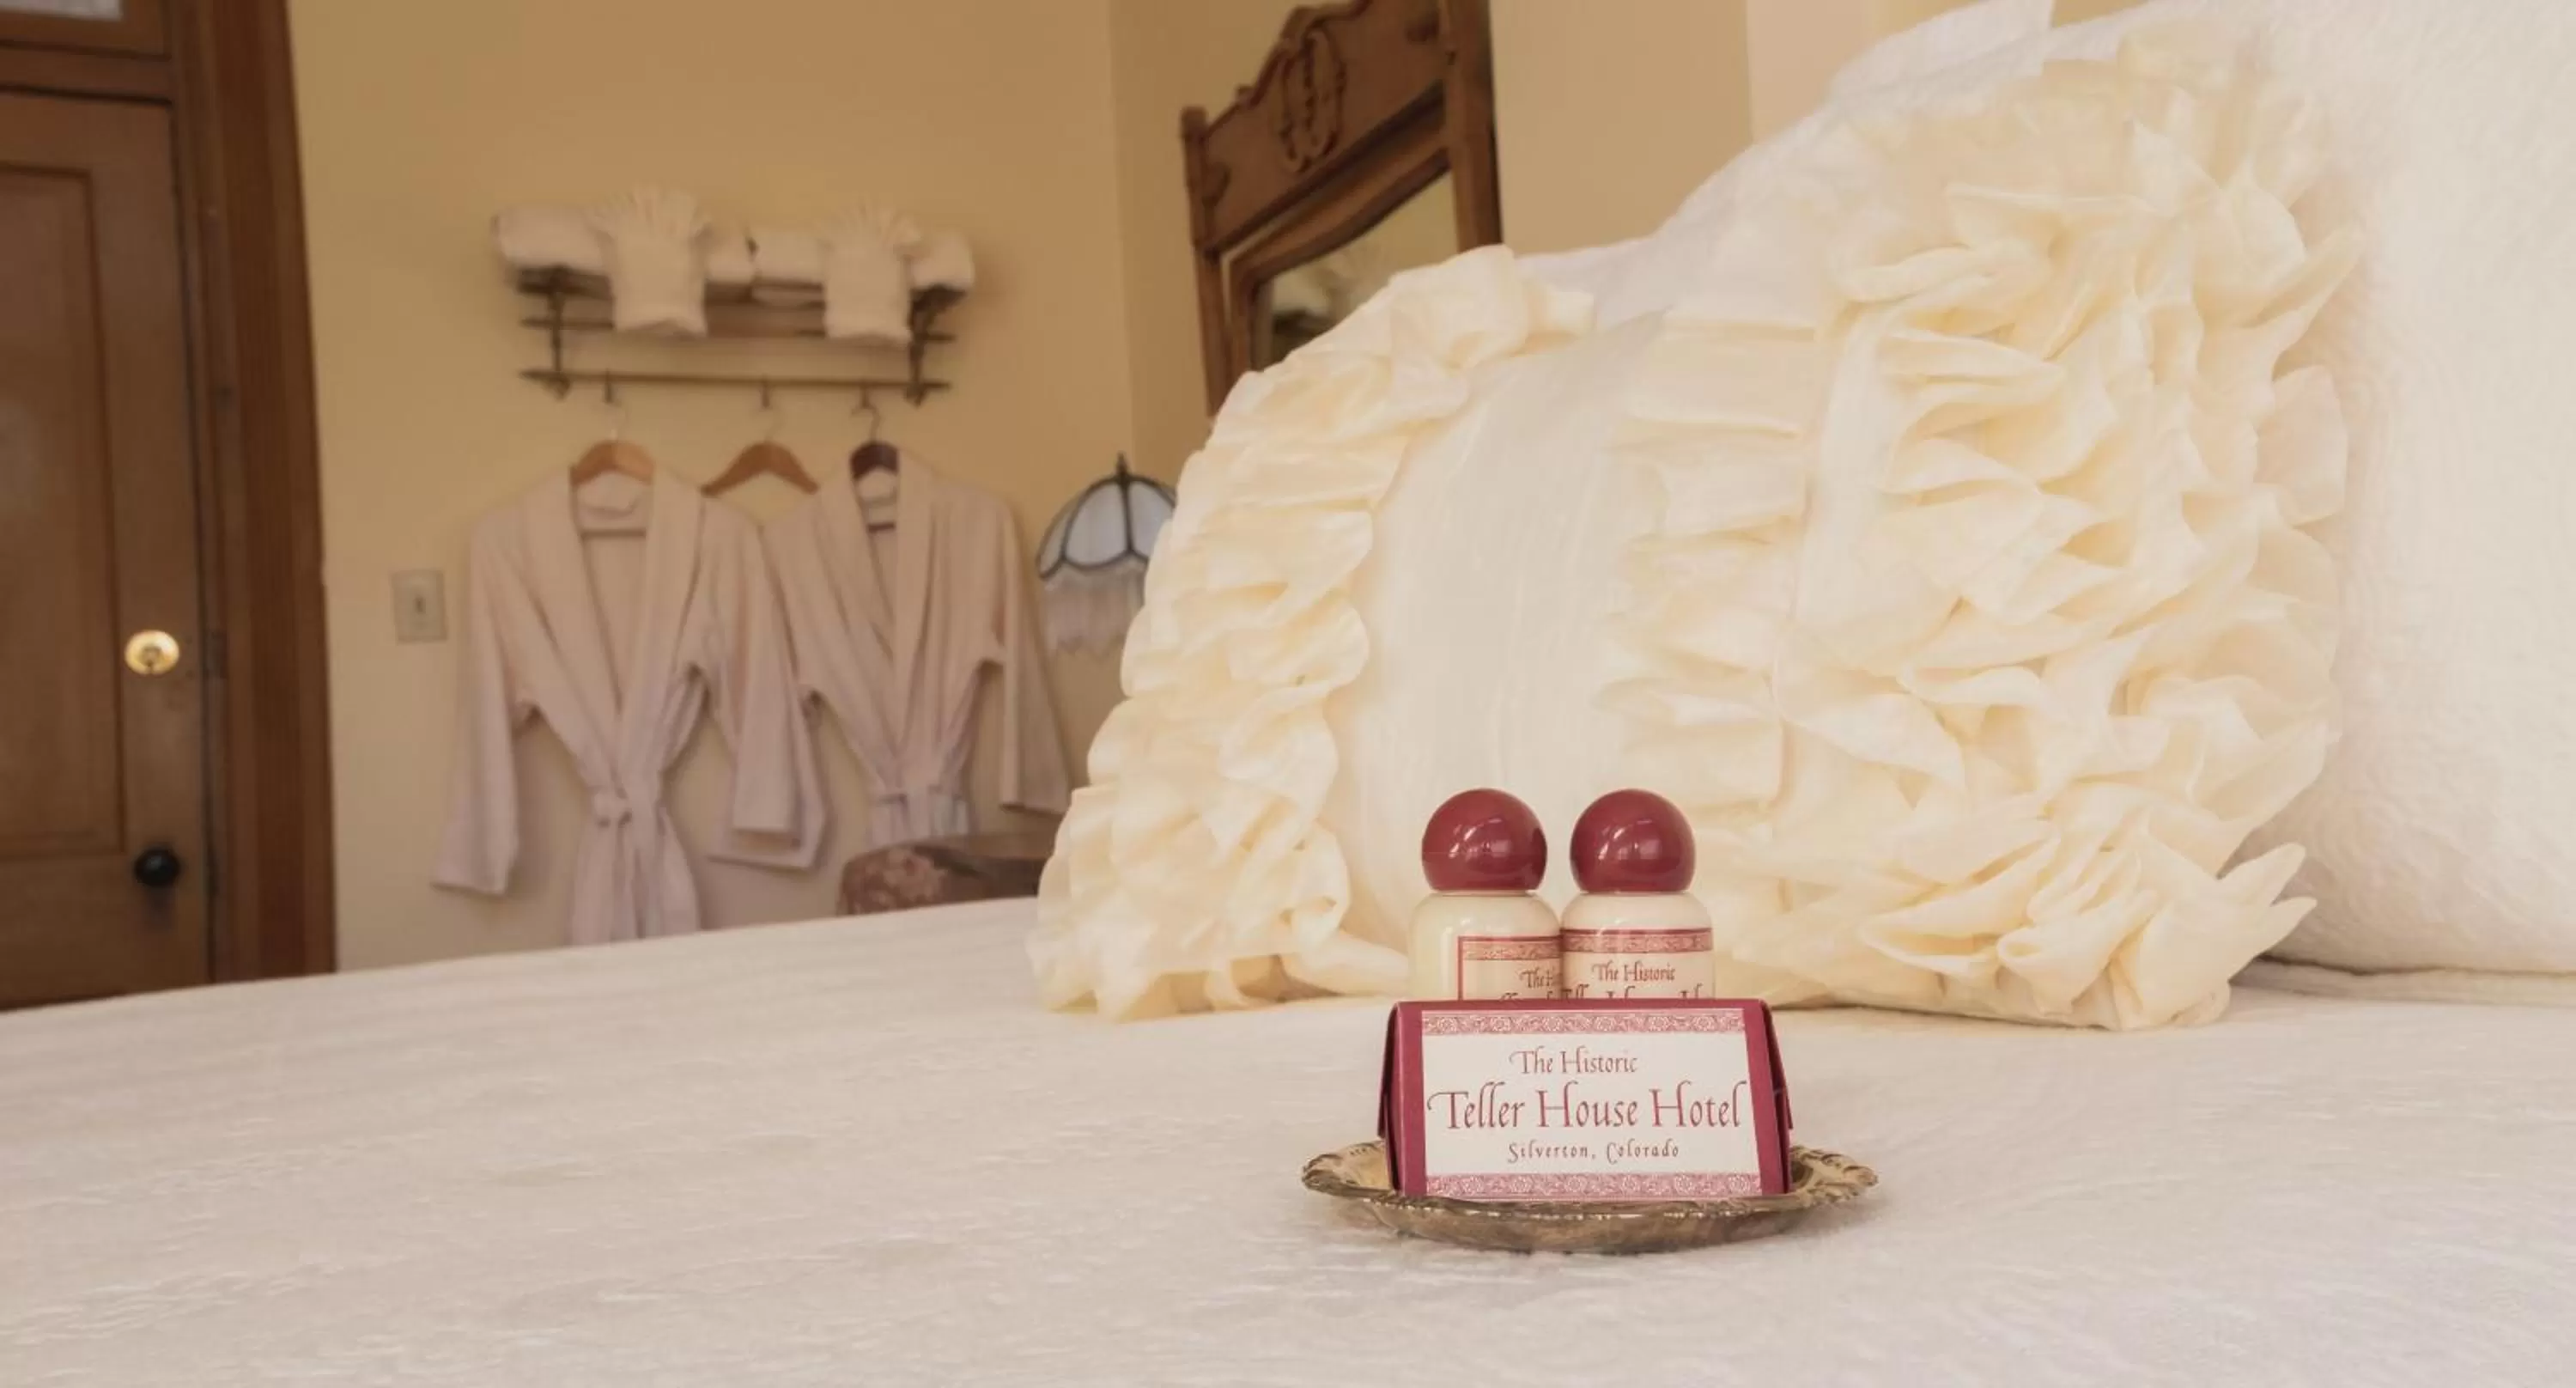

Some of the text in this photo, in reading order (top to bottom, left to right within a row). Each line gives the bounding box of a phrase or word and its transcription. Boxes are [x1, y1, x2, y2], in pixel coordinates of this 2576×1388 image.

[1521, 969, 1546, 989] The
[1592, 961, 1676, 983] The Historic
[1510, 1046, 1638, 1074] The Historic
[1427, 1080, 1747, 1129] Teller House Hotel
[1507, 1138, 1680, 1164] Silverton, Colorado
